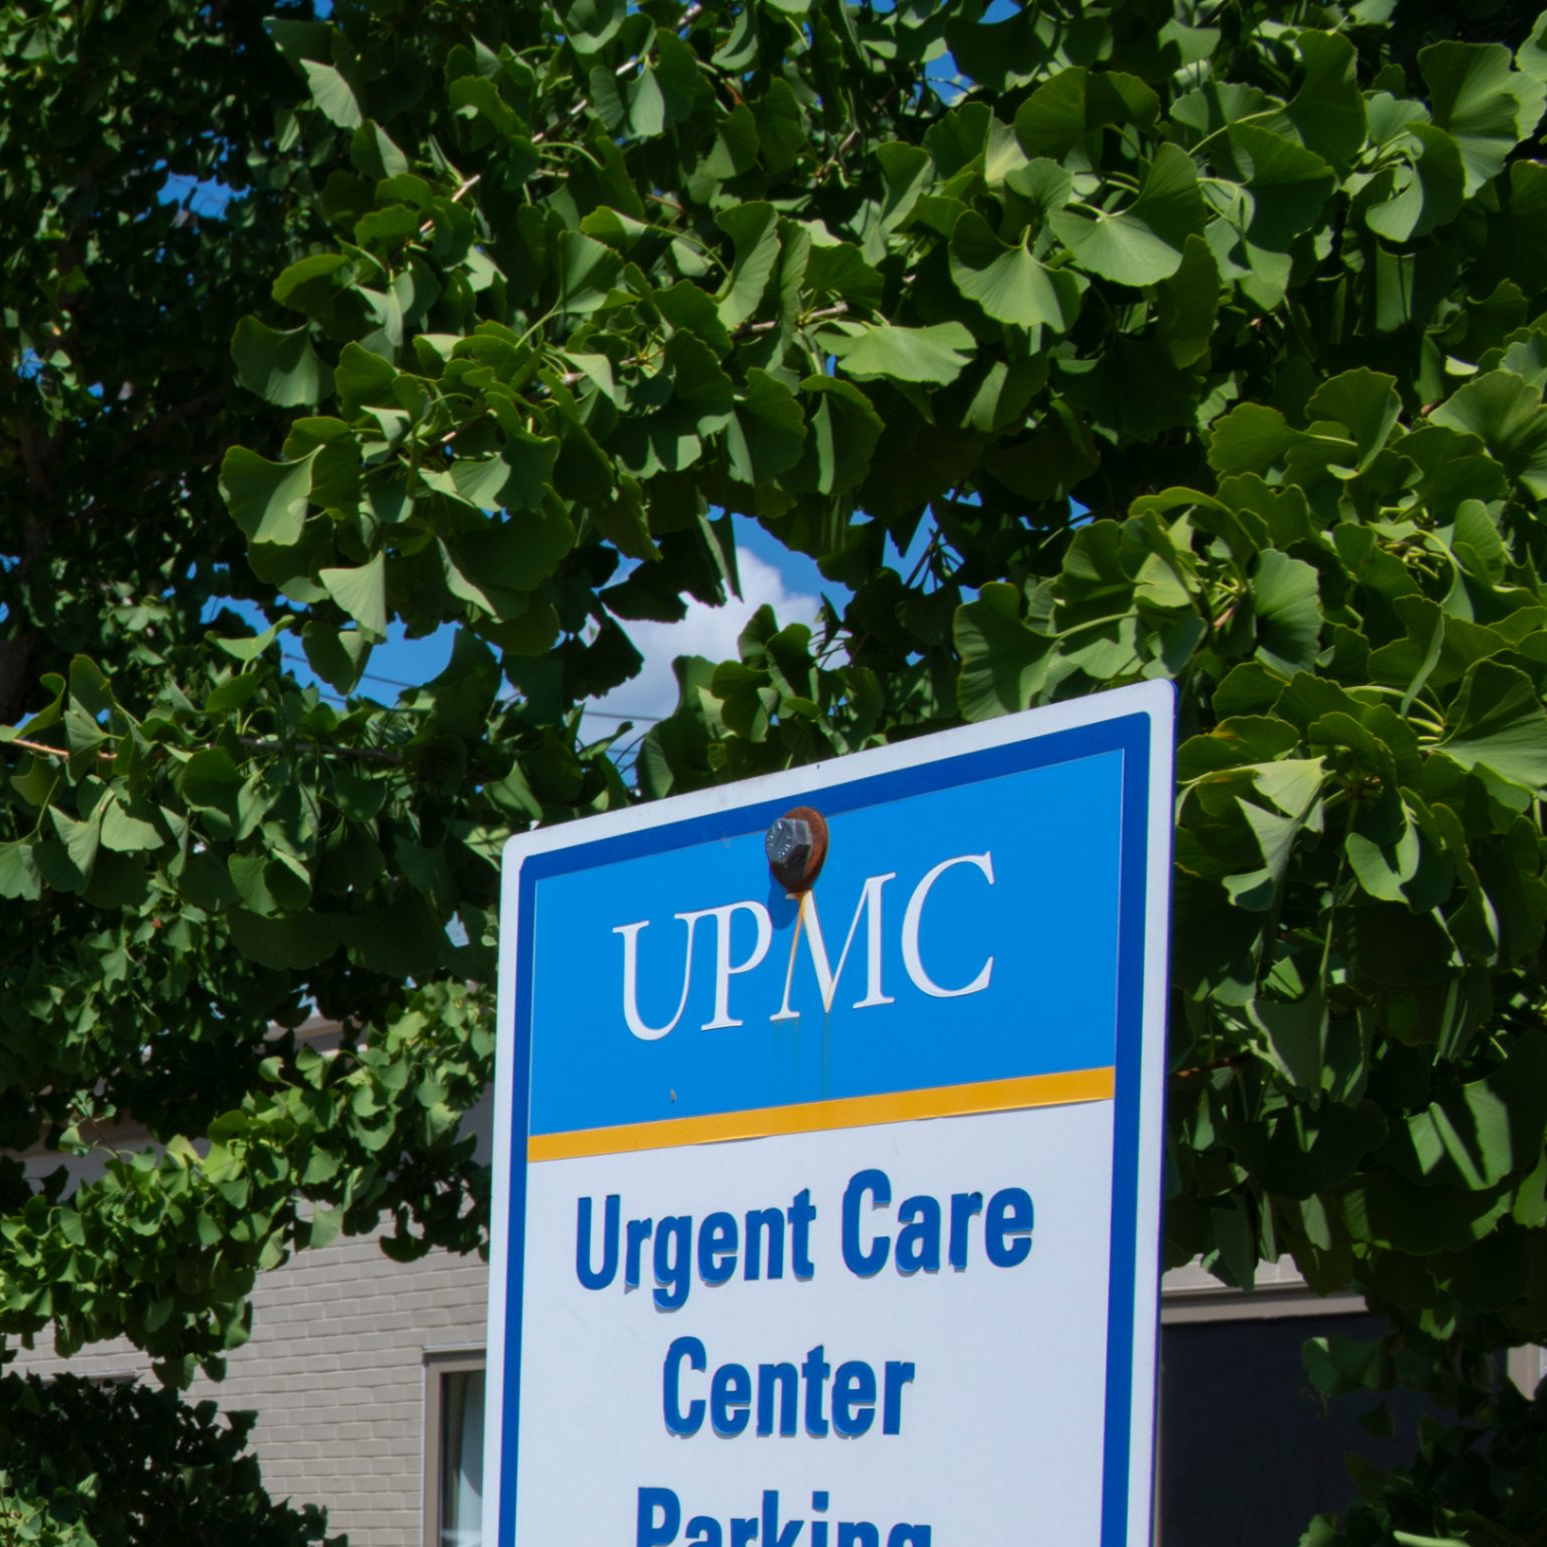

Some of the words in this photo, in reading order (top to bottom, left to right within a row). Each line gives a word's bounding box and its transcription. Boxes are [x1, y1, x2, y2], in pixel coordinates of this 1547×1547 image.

[612, 851, 995, 1041] UPMC
[577, 1188, 817, 1312] Urgent
[842, 1169, 1035, 1279] Care
[664, 1336, 916, 1439] Center
